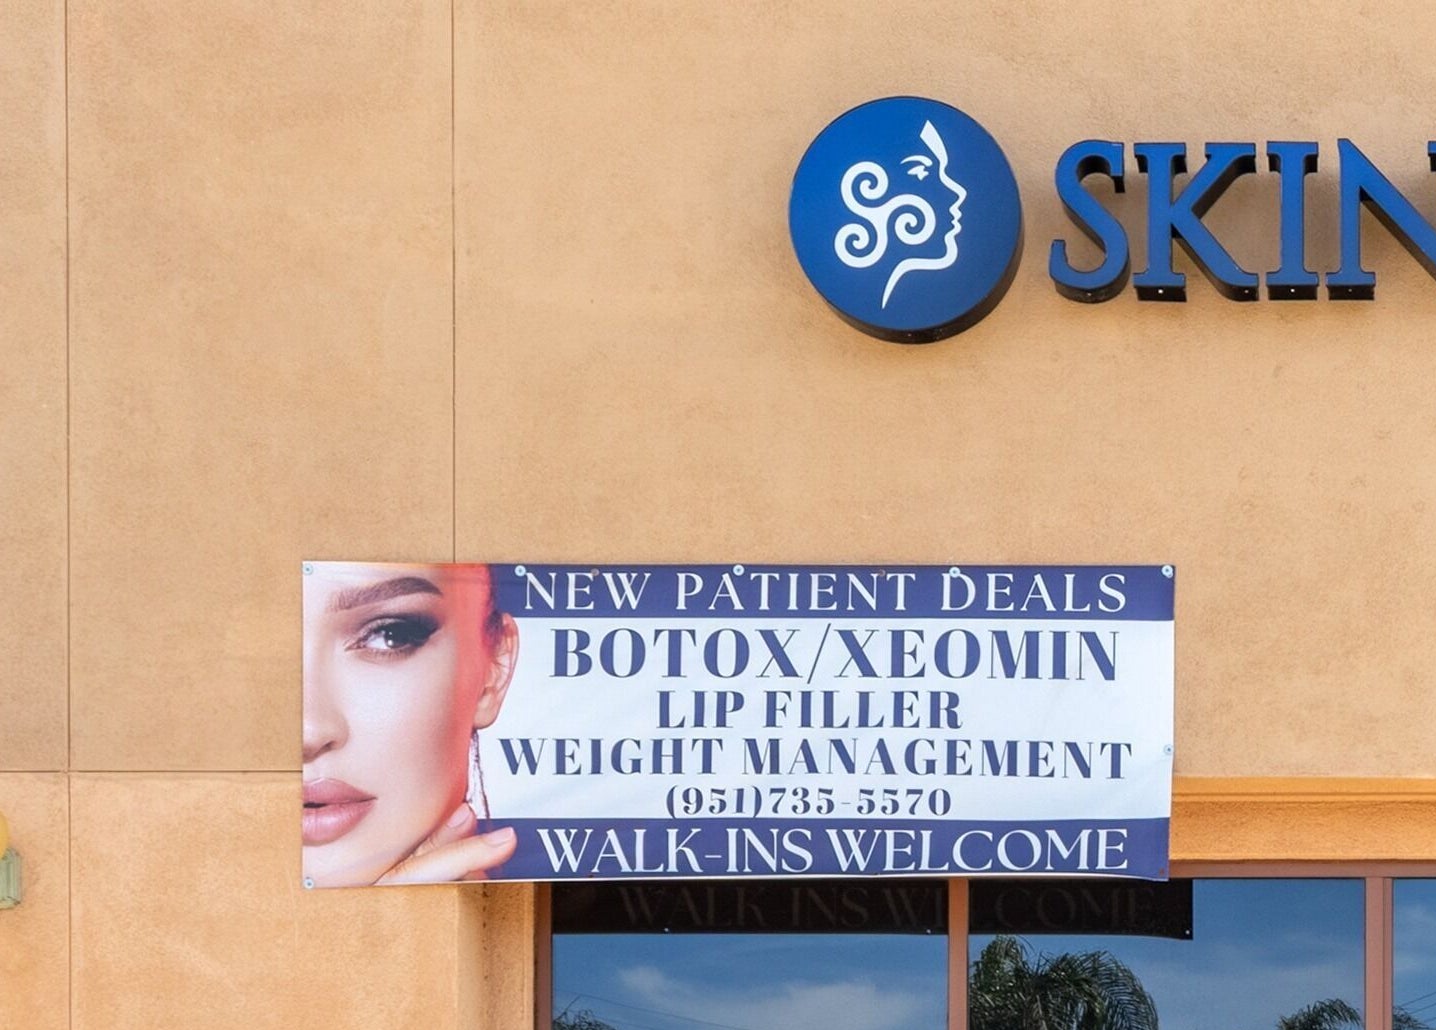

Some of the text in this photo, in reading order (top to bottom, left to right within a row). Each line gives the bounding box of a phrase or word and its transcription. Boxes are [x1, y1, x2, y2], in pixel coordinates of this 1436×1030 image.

[524, 571, 1127, 614] NEW PATIENT DEALS
[550, 622, 1119, 682] BOTOX/XEOMIN
[657, 689, 963, 731] LIP FILLER
[500, 737, 1133, 780] WEIGHT MANAGEMENT
[666, 785, 952, 818] (951)735-5570
[538, 827, 1129, 874] WALK-INS WELCOME
